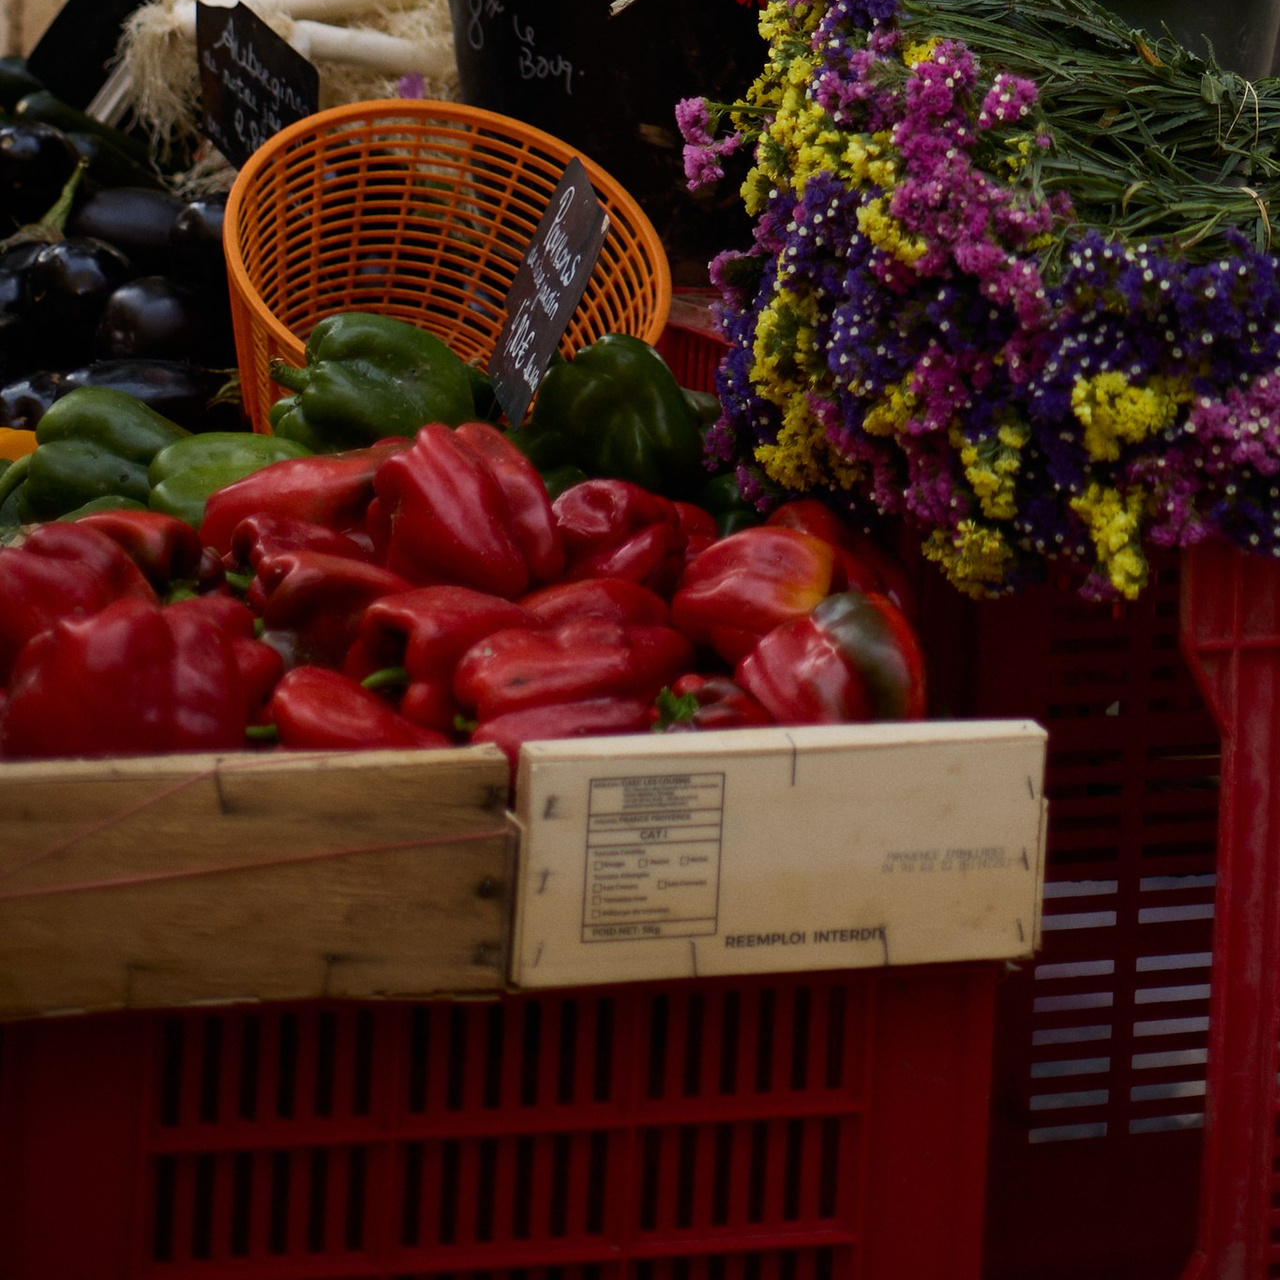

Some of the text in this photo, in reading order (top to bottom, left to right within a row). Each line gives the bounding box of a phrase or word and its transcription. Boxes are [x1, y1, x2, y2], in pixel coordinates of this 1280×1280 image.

[640, 830, 661, 840] CAT
[725, 926, 886, 948] REEMPLOI INTERDIT
